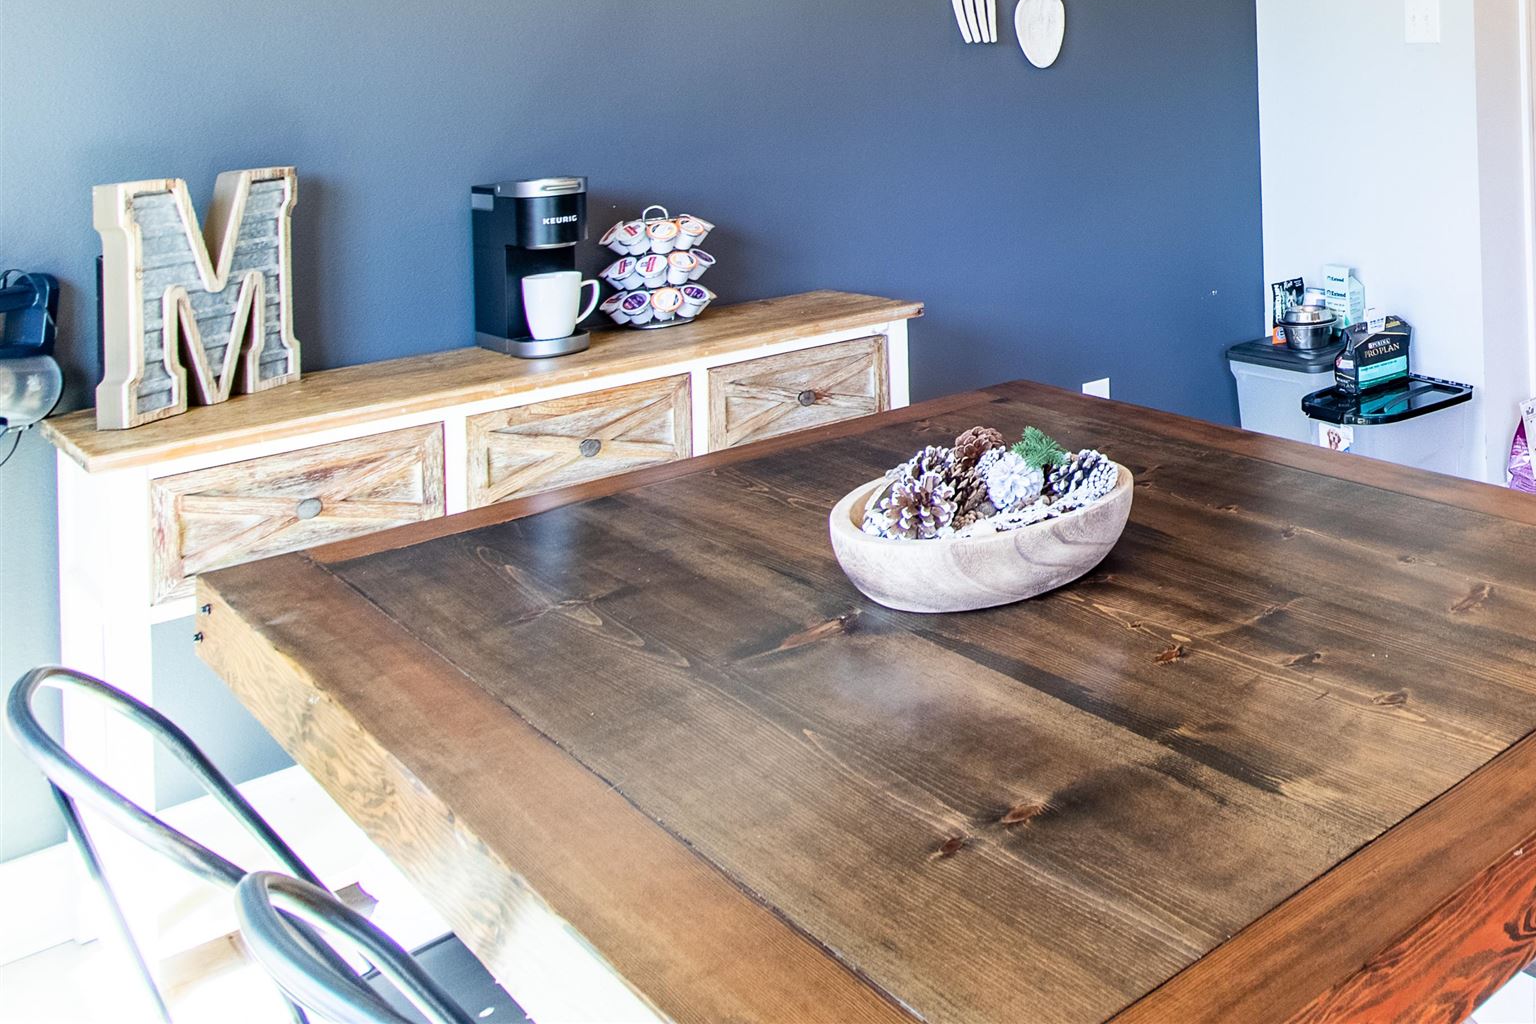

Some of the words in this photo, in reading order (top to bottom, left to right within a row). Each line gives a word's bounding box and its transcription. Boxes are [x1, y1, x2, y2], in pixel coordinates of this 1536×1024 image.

[542, 214, 578, 225] KEURIG
[93, 166, 301, 431] M
[1364, 348, 1379, 358] PRO
[1379, 342, 1400, 355] PLAN
